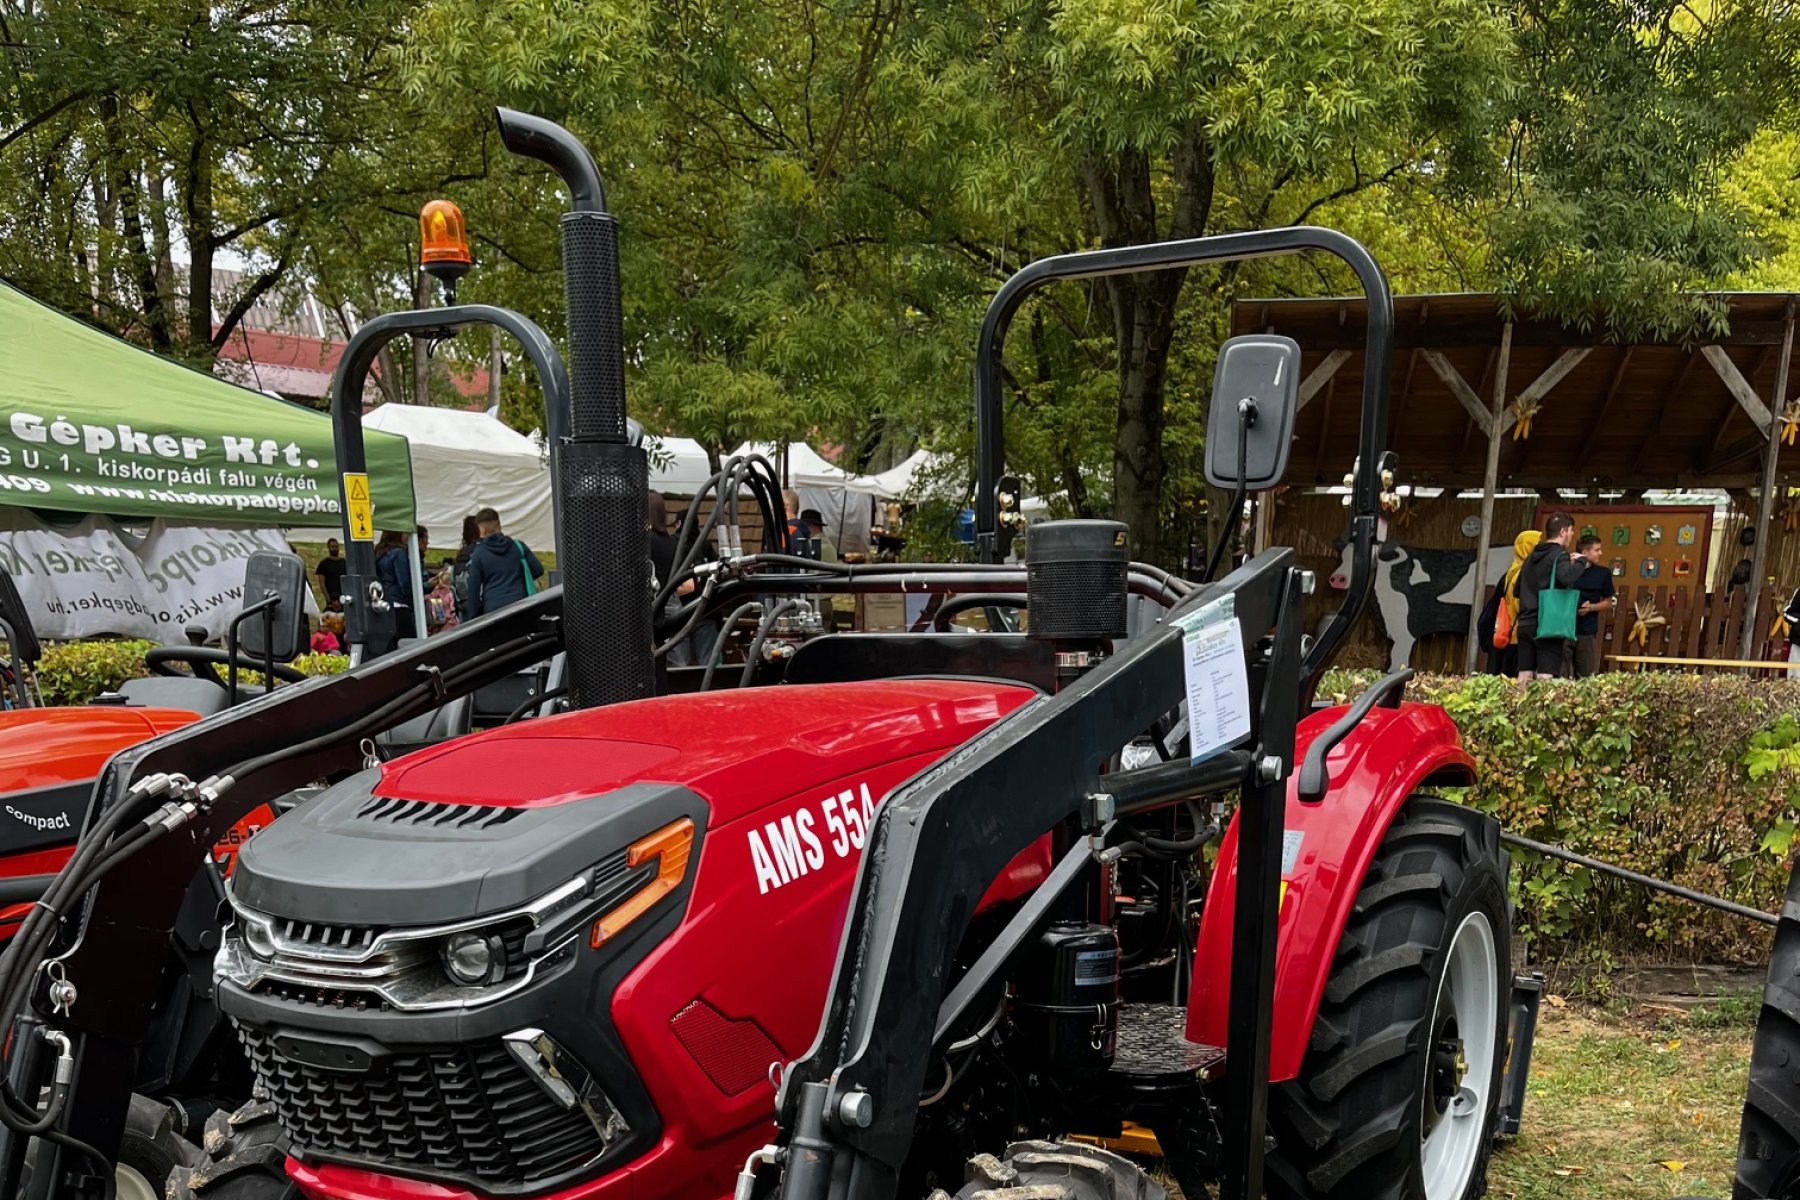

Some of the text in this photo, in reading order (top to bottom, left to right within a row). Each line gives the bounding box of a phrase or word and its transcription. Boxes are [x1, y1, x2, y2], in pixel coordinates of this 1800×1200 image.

[10, 412, 320, 469] Gépker Kft.
[98, 457, 211, 487] kiskorpádi
[219, 470, 257, 488] falu
[264, 474, 318, 493] végén
[5, 805, 71, 831] compact
[747, 807, 825, 895] AMS
